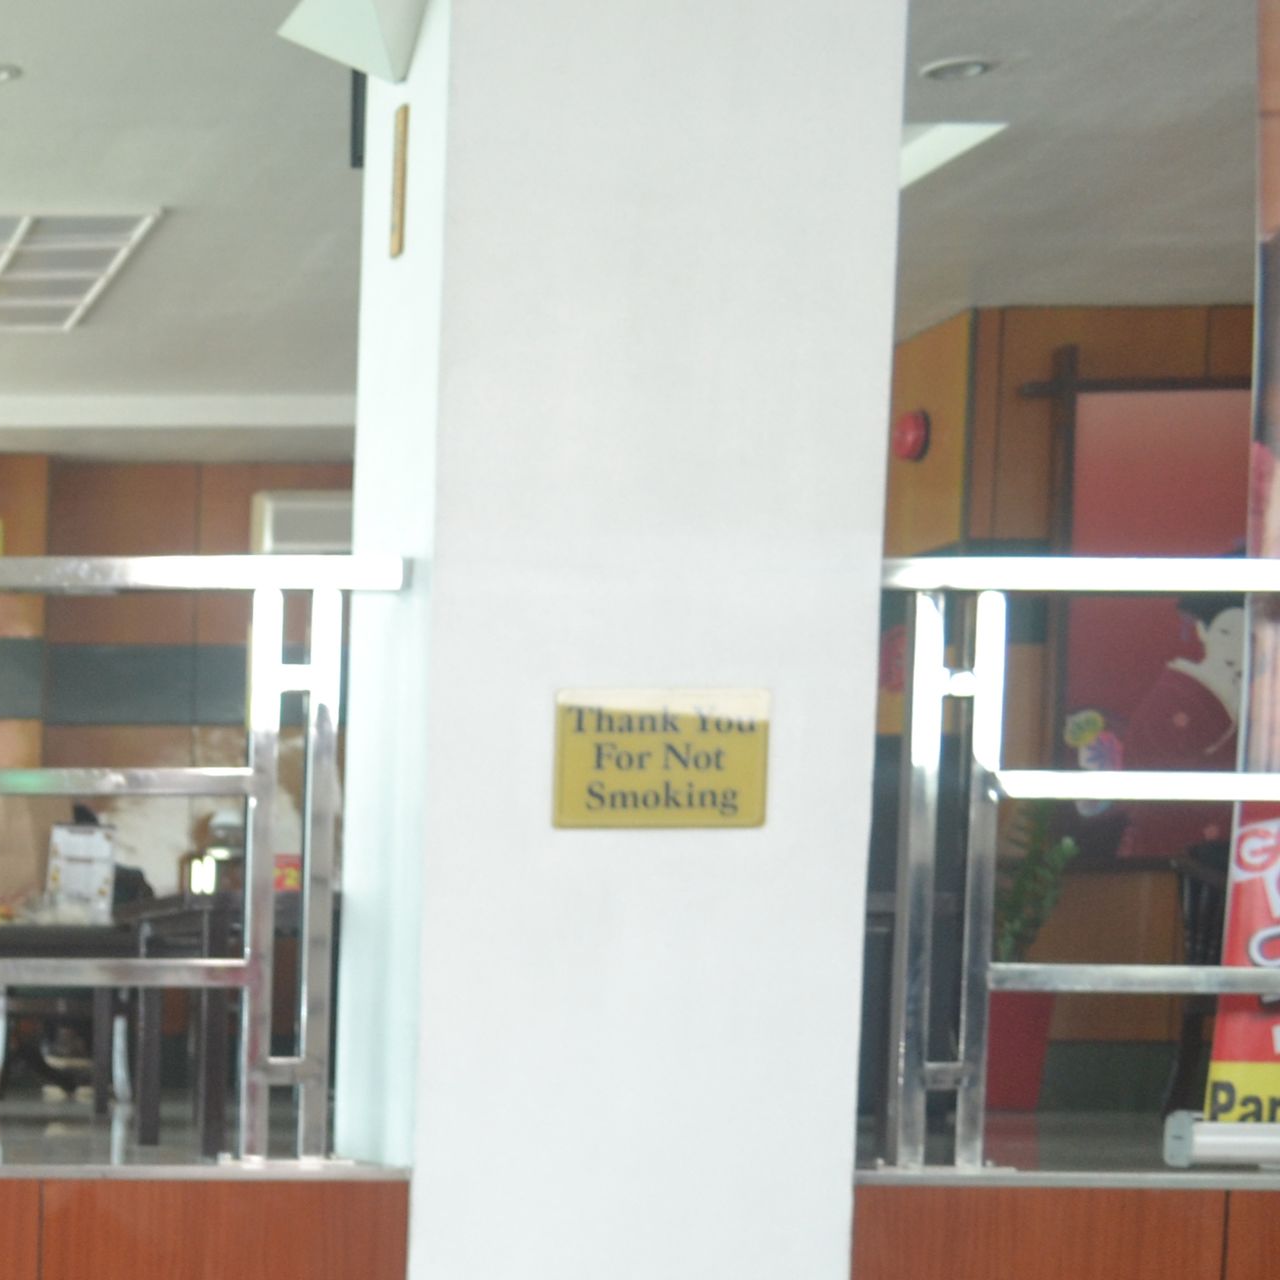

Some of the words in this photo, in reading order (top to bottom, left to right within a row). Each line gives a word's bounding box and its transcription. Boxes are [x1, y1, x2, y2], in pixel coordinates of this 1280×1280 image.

[567, 703, 681, 734] Thank
[695, 705, 757, 734] You
[593, 741, 652, 771] For
[662, 741, 726, 771] Not
[585, 780, 739, 817] Smoking
